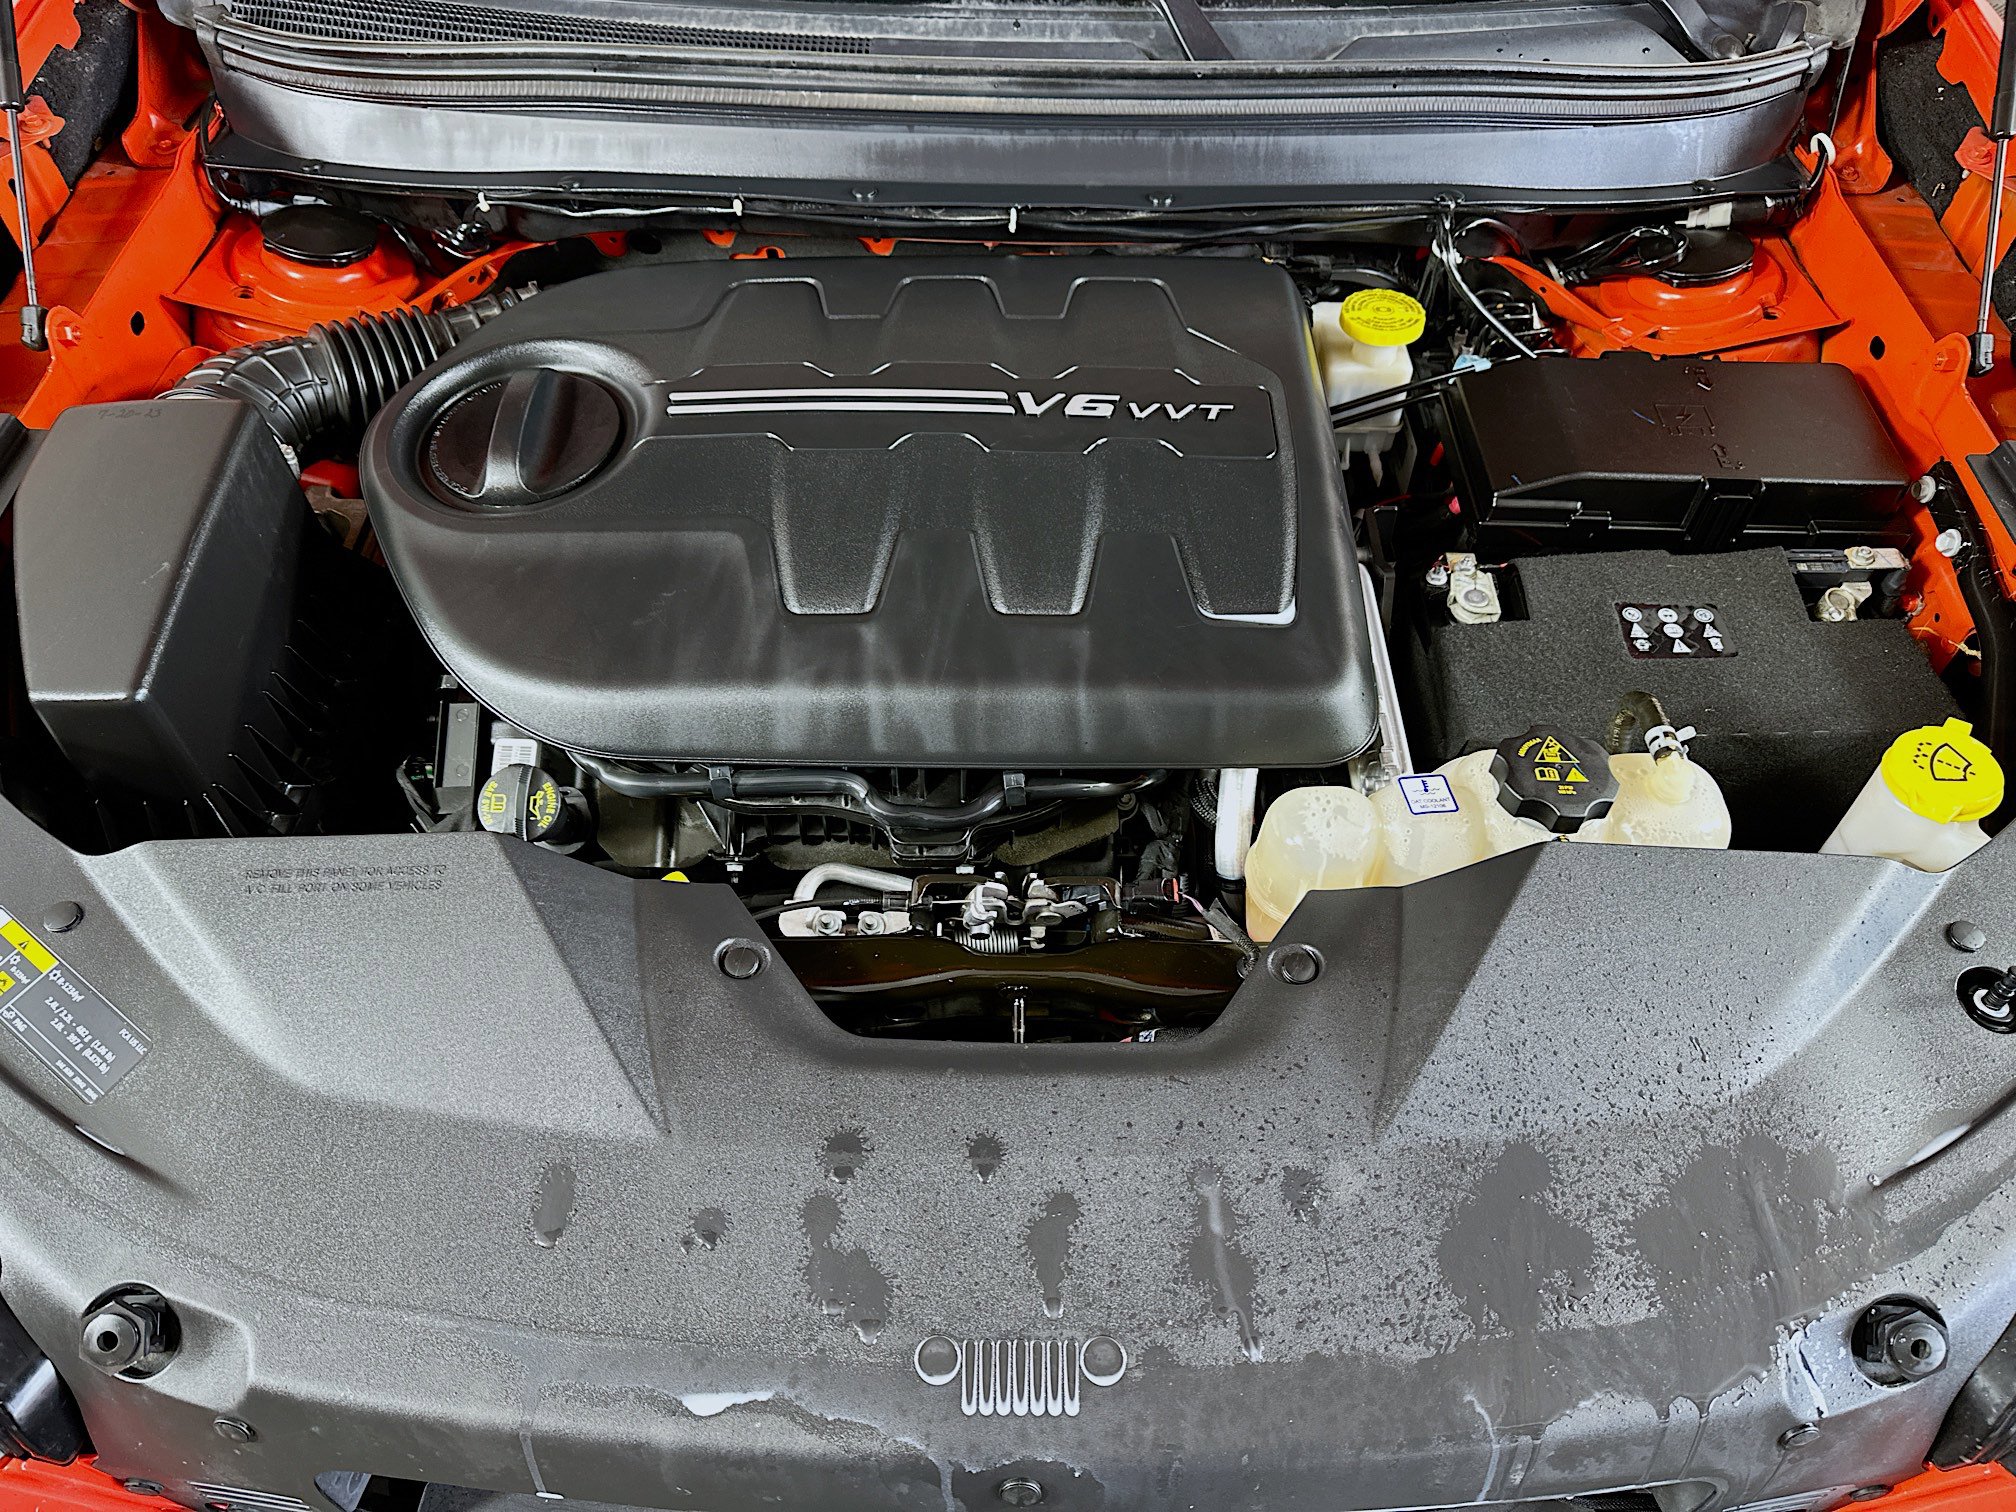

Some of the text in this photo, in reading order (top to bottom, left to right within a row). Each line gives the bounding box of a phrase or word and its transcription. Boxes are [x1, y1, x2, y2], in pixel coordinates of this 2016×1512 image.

[1015, 391, 1234, 420] V6 VVT
[537, 781, 556, 829] ENGINE OIL
[245, 868, 292, 880] REMOVE
[296, 867, 320, 879] THIS
[386, 865, 429, 876] ACCESS
[270, 882, 293, 894] FILL
[331, 881, 348, 892] ON
[350, 881, 385, 892] SOME
[388, 879, 444, 891] VEHICLES
[11, 1017, 27, 1032] PAG
[118, 1028, 131, 1041] FCA
[134, 1043, 147, 1055] LLC
